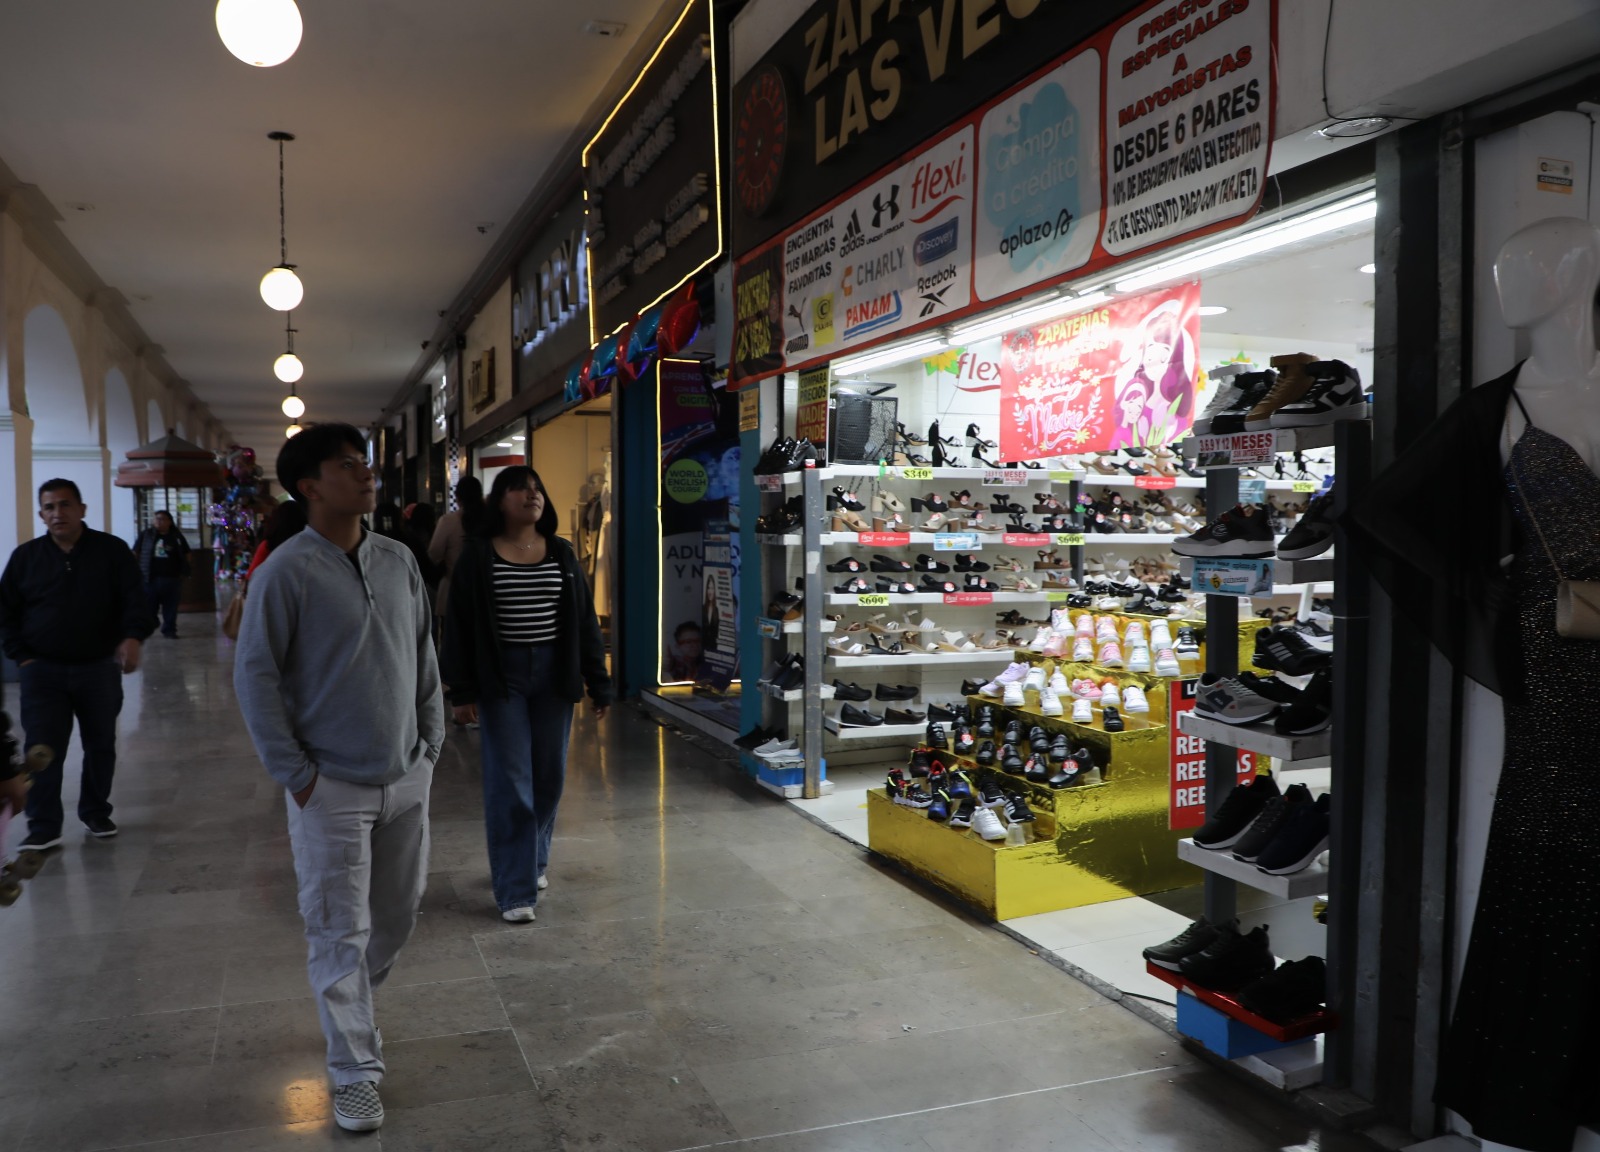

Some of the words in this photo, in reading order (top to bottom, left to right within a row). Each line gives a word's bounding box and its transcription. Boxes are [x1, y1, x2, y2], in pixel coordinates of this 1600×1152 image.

[1121, 0, 1250, 78] ESPECIALES
[815, 39, 901, 166] LAS
[918, 0, 1042, 83] VE
[1172, 53, 1188, 76] A
[1118, 45, 1253, 128] MAYORISTAS
[996, 114, 1074, 172] Compra
[1114, 120, 1169, 173] DESDE
[1174, 113, 1185, 144] 6
[1192, 78, 1260, 137] PARES
[911, 142, 966, 209] flexi
[1127, 175, 1136, 201] DE
[1137, 156, 1179, 197] DESCUENTO
[1179, 145, 1202, 178] PAGO
[1203, 139, 1218, 169] EN
[1218, 121, 1261, 164] EFECTIVO
[1011, 155, 1077, 205] crédito
[1119, 214, 1131, 240] DE
[1130, 197, 1179, 236] DESCUENTO
[1179, 189, 1202, 221] PAGO
[1200, 181, 1220, 212] CON
[1219, 166, 1258, 205] TARJETA
[786, 216, 834, 255] ENCUENTRA
[840, 234, 865, 258] adidas
[1000, 220, 1052, 258] aplazo
[786, 257, 800, 275] TUS
[801, 237, 836, 267] MARCAS
[857, 246, 905, 286] CHARLY
[789, 261, 832, 294] FAVORITAS
[917, 263, 957, 294] Reebok
[846, 292, 891, 328] PANAM
[1037, 309, 1110, 346] ZAPATERIAS
[785, 334, 809, 355] PUMA
[800, 371, 827, 389] COMPARA
[956, 353, 1001, 380] flex
[800, 384, 827, 402] PRECIOS
[800, 403, 826, 425] NADIE
[1231, 433, 1273, 450] MESES
[668, 478, 706, 486] ENGLISH
[670, 470, 705, 478] WORLD
